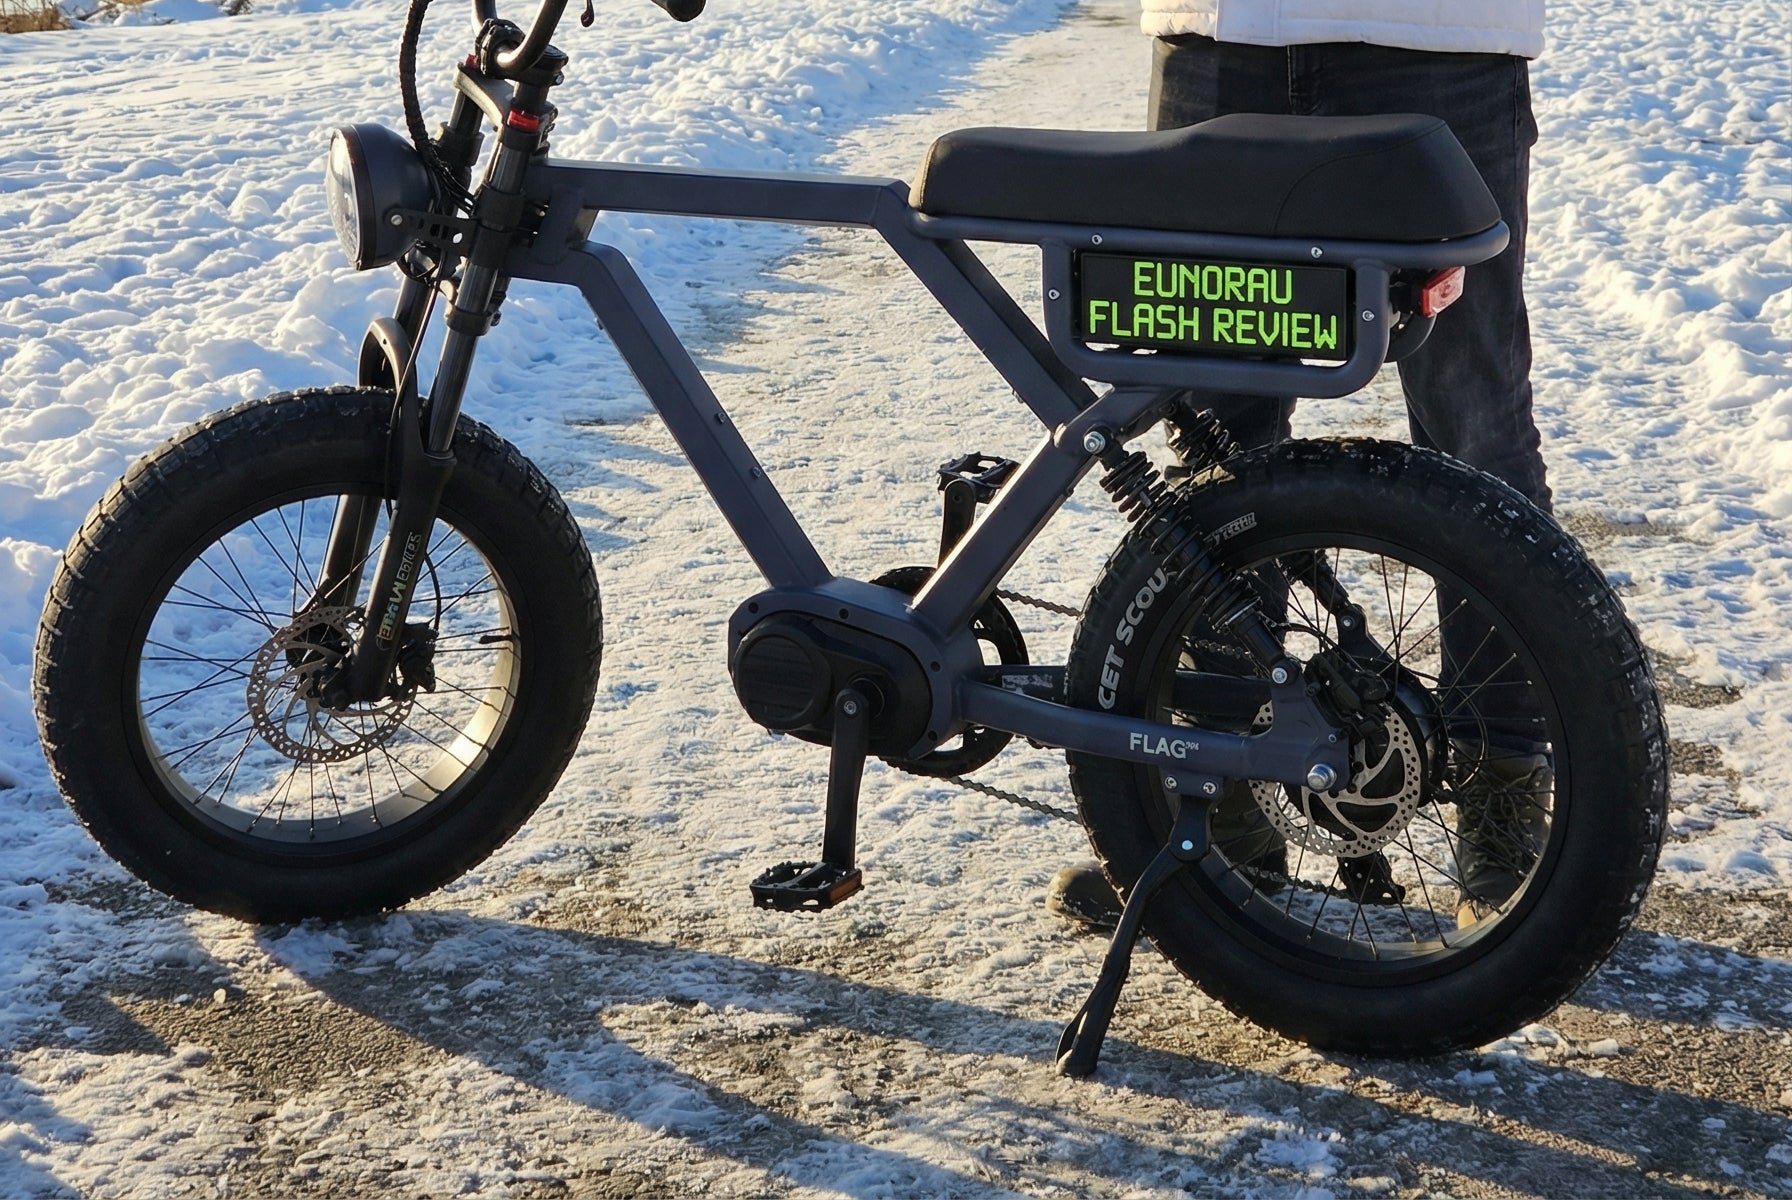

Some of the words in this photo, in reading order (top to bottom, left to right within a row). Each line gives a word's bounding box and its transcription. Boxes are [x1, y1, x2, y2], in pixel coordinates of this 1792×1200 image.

[1133, 261, 1293, 305] EUNORAU
[1089, 300, 1200, 342] FLASH
[1213, 307, 1337, 350] REVIEW
[1129, 732, 1187, 759] FLAG
